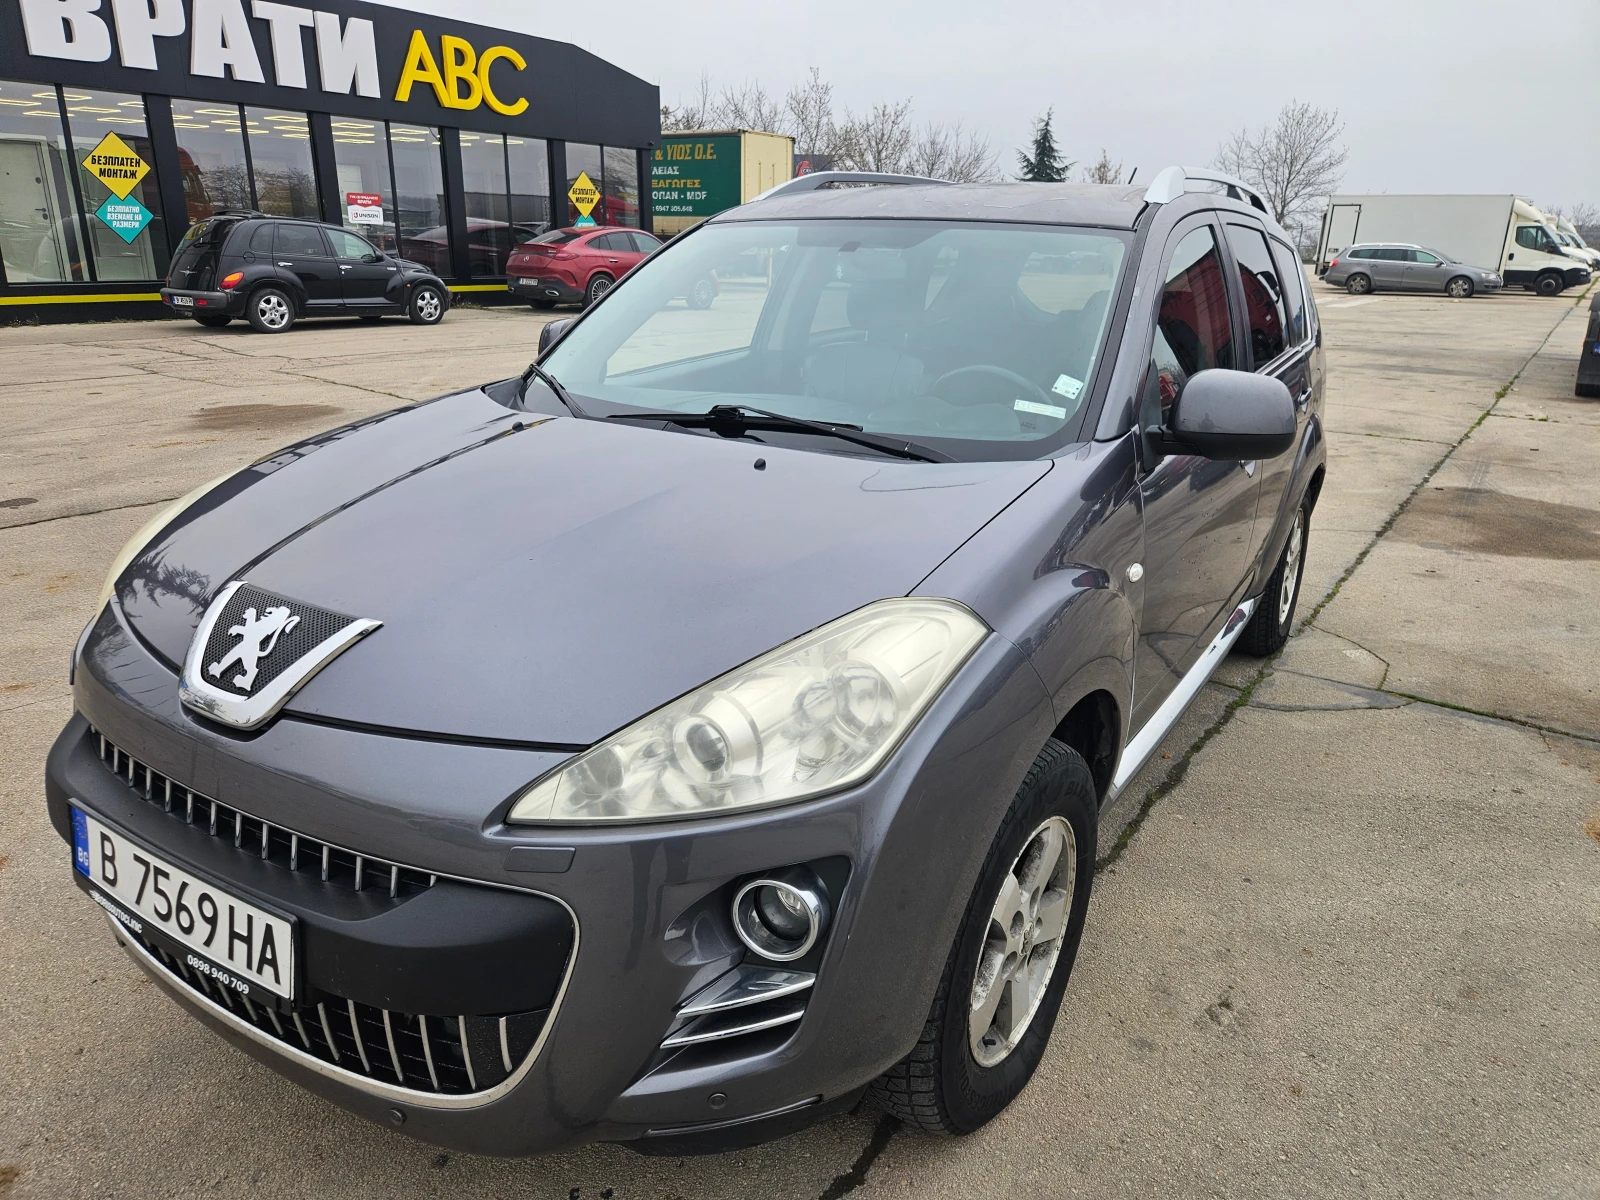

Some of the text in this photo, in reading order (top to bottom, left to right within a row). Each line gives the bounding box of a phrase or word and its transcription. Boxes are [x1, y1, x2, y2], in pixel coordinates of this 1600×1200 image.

[18, 0, 381, 98] ВРАТИ
[394, 29, 529, 116] ABC
[666, 144, 692, 160] ΥΙΟΣ
[91, 154, 141, 168] БЕЗПЛАТЕН
[98, 167, 138, 180] МОНТАЖ
[651, 166, 679, 175] ΛΕΙΑΣ
[651, 179, 701, 188] ΞΑΓΩΓΕΣ
[652, 191, 679, 200] ΟΠΑΝ
[686, 191, 708, 200] MDF
[107, 204, 140, 213] БЕЗПЛАТНО
[134, 213, 143, 221] НА
[112, 220, 140, 229] РАЗМЕРИ
[77, 846, 89, 866] BG
[187, 954, 250, 994] 0898 940 709
